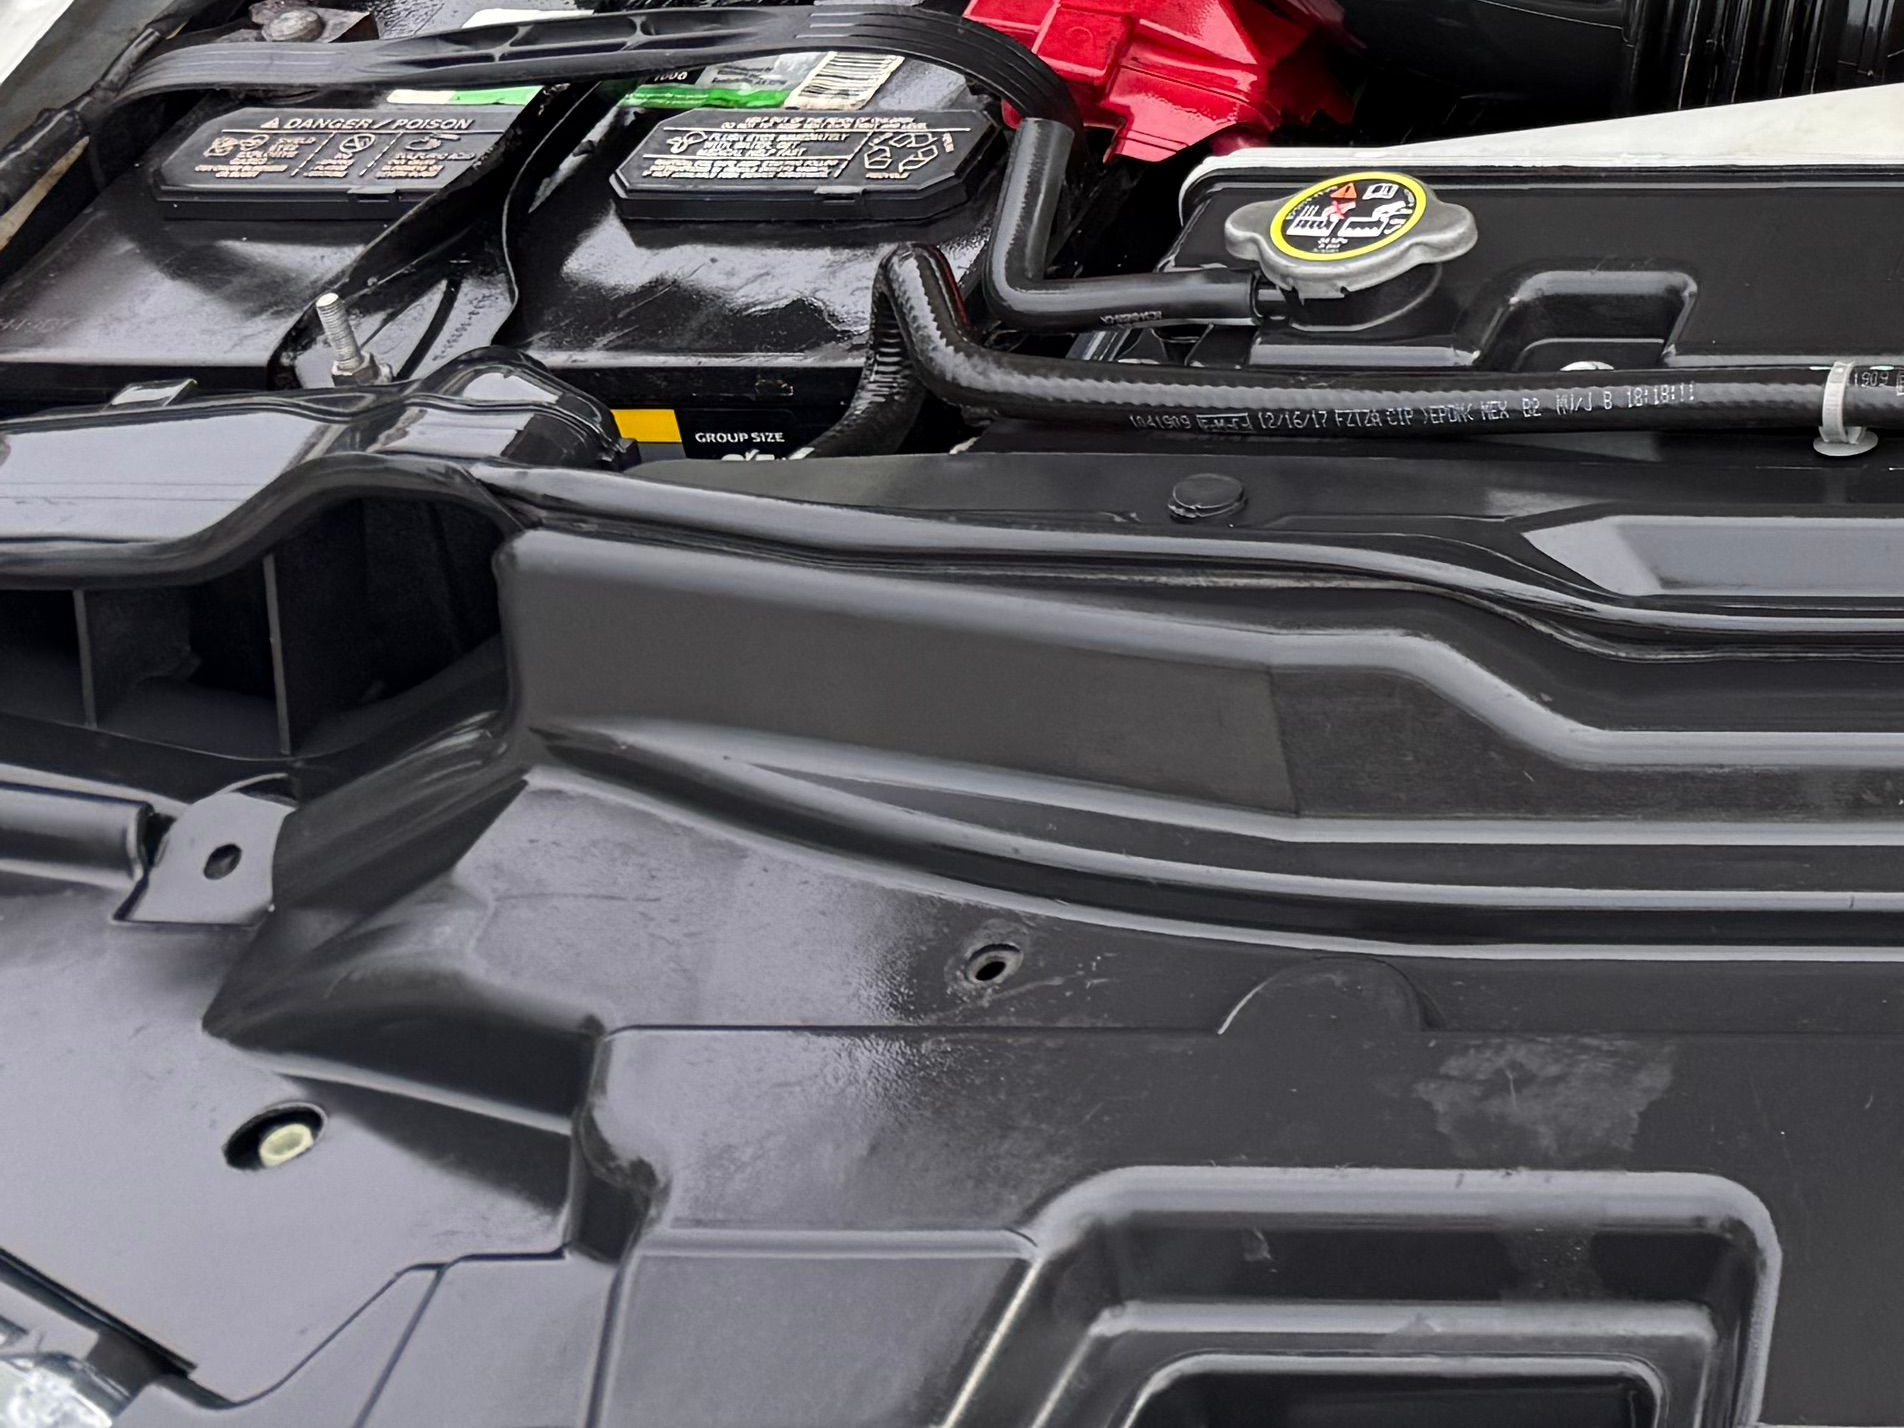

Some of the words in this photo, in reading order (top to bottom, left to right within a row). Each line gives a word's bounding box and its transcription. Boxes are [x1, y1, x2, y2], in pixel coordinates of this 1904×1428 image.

[284, 117, 372, 130] DANGER
[392, 117, 474, 130] POISON
[695, 431, 748, 443] GROUP
[751, 431, 785, 443] SIZE
